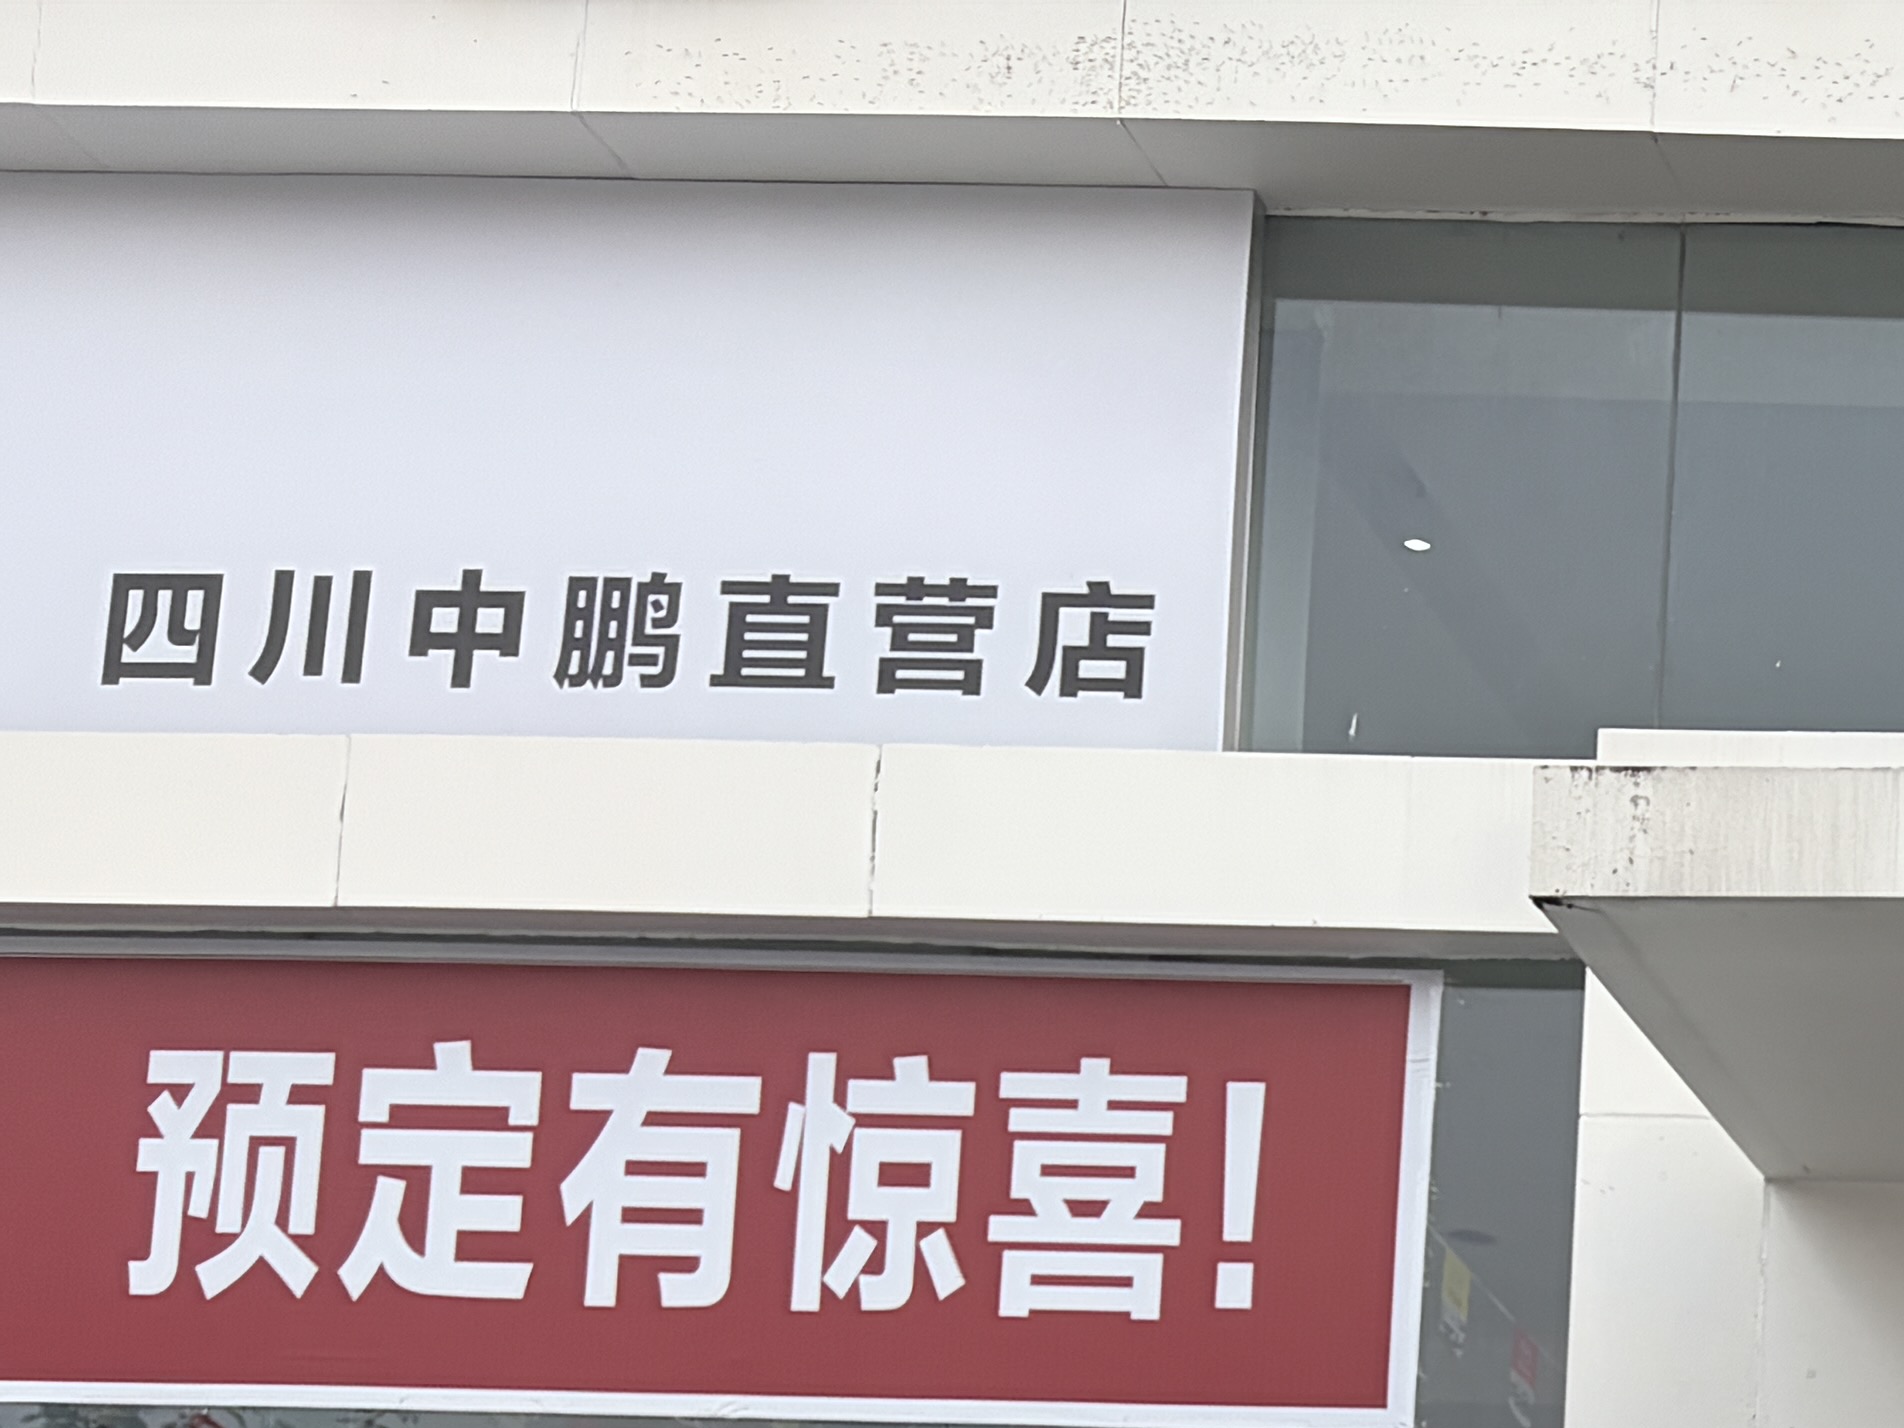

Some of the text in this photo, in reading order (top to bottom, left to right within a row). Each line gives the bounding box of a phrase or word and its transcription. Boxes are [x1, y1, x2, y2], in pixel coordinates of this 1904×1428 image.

[100, 566, 1160, 702] 四川中鹏直营店
[126, 1040, 1267, 1324] 预定有惊喜!
